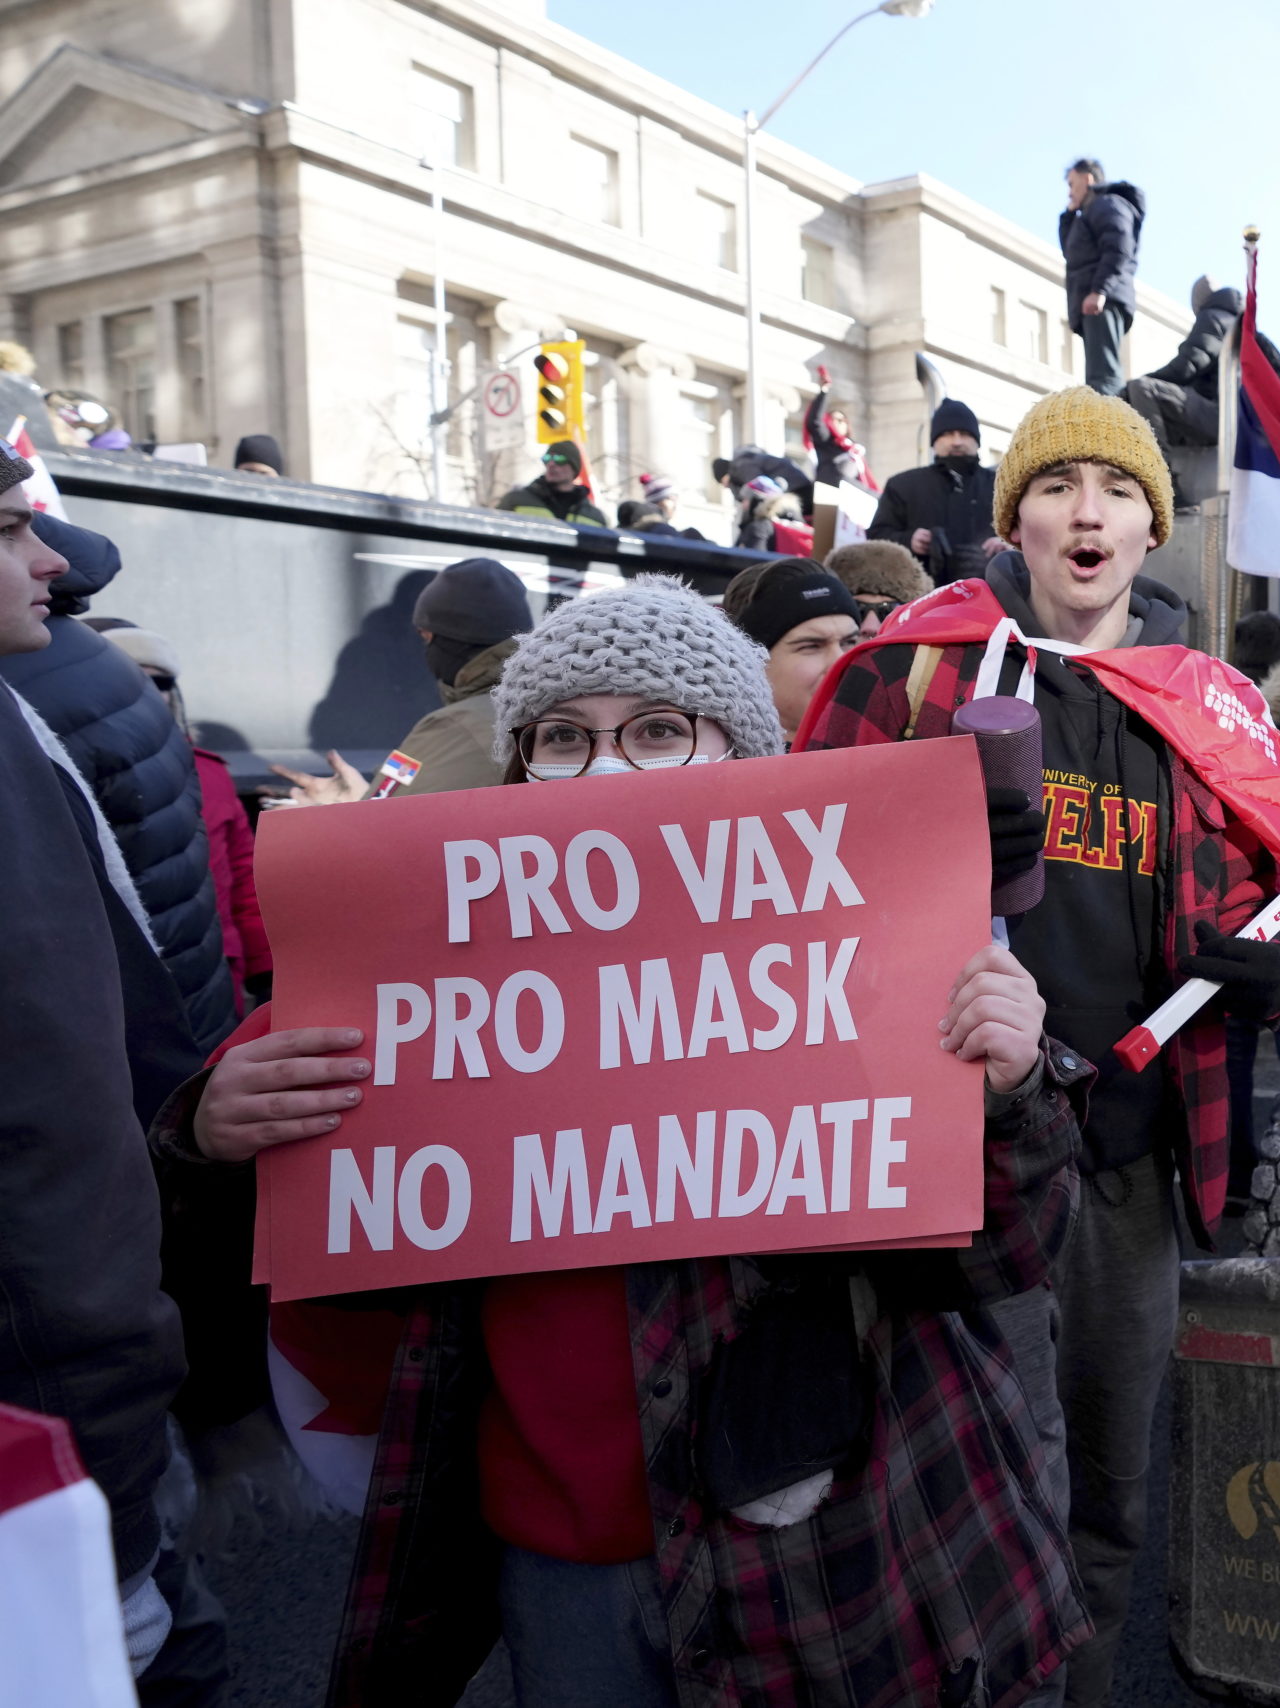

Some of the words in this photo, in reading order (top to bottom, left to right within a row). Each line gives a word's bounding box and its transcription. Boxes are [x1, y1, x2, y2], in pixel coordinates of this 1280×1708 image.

[1103, 784, 1123, 795] OF
[444, 829, 640, 943] PRO
[659, 803, 866, 923] VAX
[373, 970, 565, 1087] PRO
[598, 936, 861, 1069] MASK
[327, 1144, 472, 1254] NO
[510, 1096, 912, 1242] MANDATE
[1223, 1555, 1256, 1580] WE
